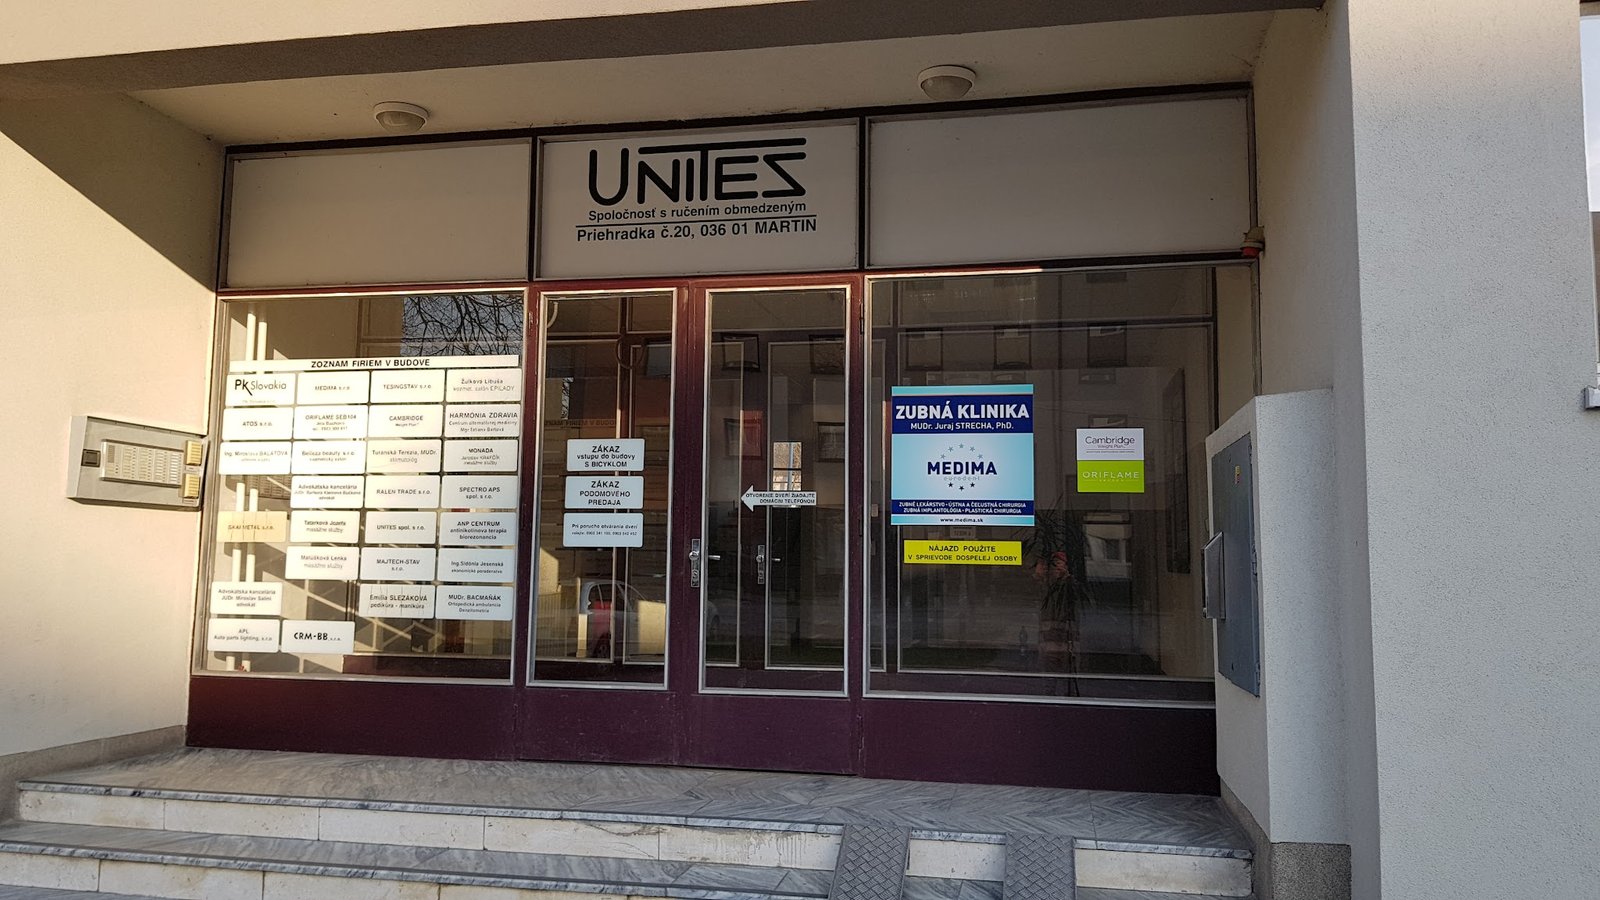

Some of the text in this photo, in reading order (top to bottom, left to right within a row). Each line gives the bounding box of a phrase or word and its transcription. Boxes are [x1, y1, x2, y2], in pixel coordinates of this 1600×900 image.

[588, 138, 806, 206] UNITES
[588, 202, 806, 222] Spoločnosť s ručením obmedzeným
[578, 218, 817, 242] Priehradka č.20, 036 01 MARTIN
[250, 380, 287, 390] Slovakia
[895, 400, 1030, 420] ZUBNÁ KLINIKA
[935, 422, 954, 431] Juraj
[955, 422, 994, 430] STRECHA,
[1085, 436, 1135, 446] Cambridge
[592, 444, 620, 453] ZÁKAZ
[928, 461, 997, 476] MEDIMA
[591, 480, 620, 488] ZÁKAZ
[294, 632, 328, 641] CRM-BB
